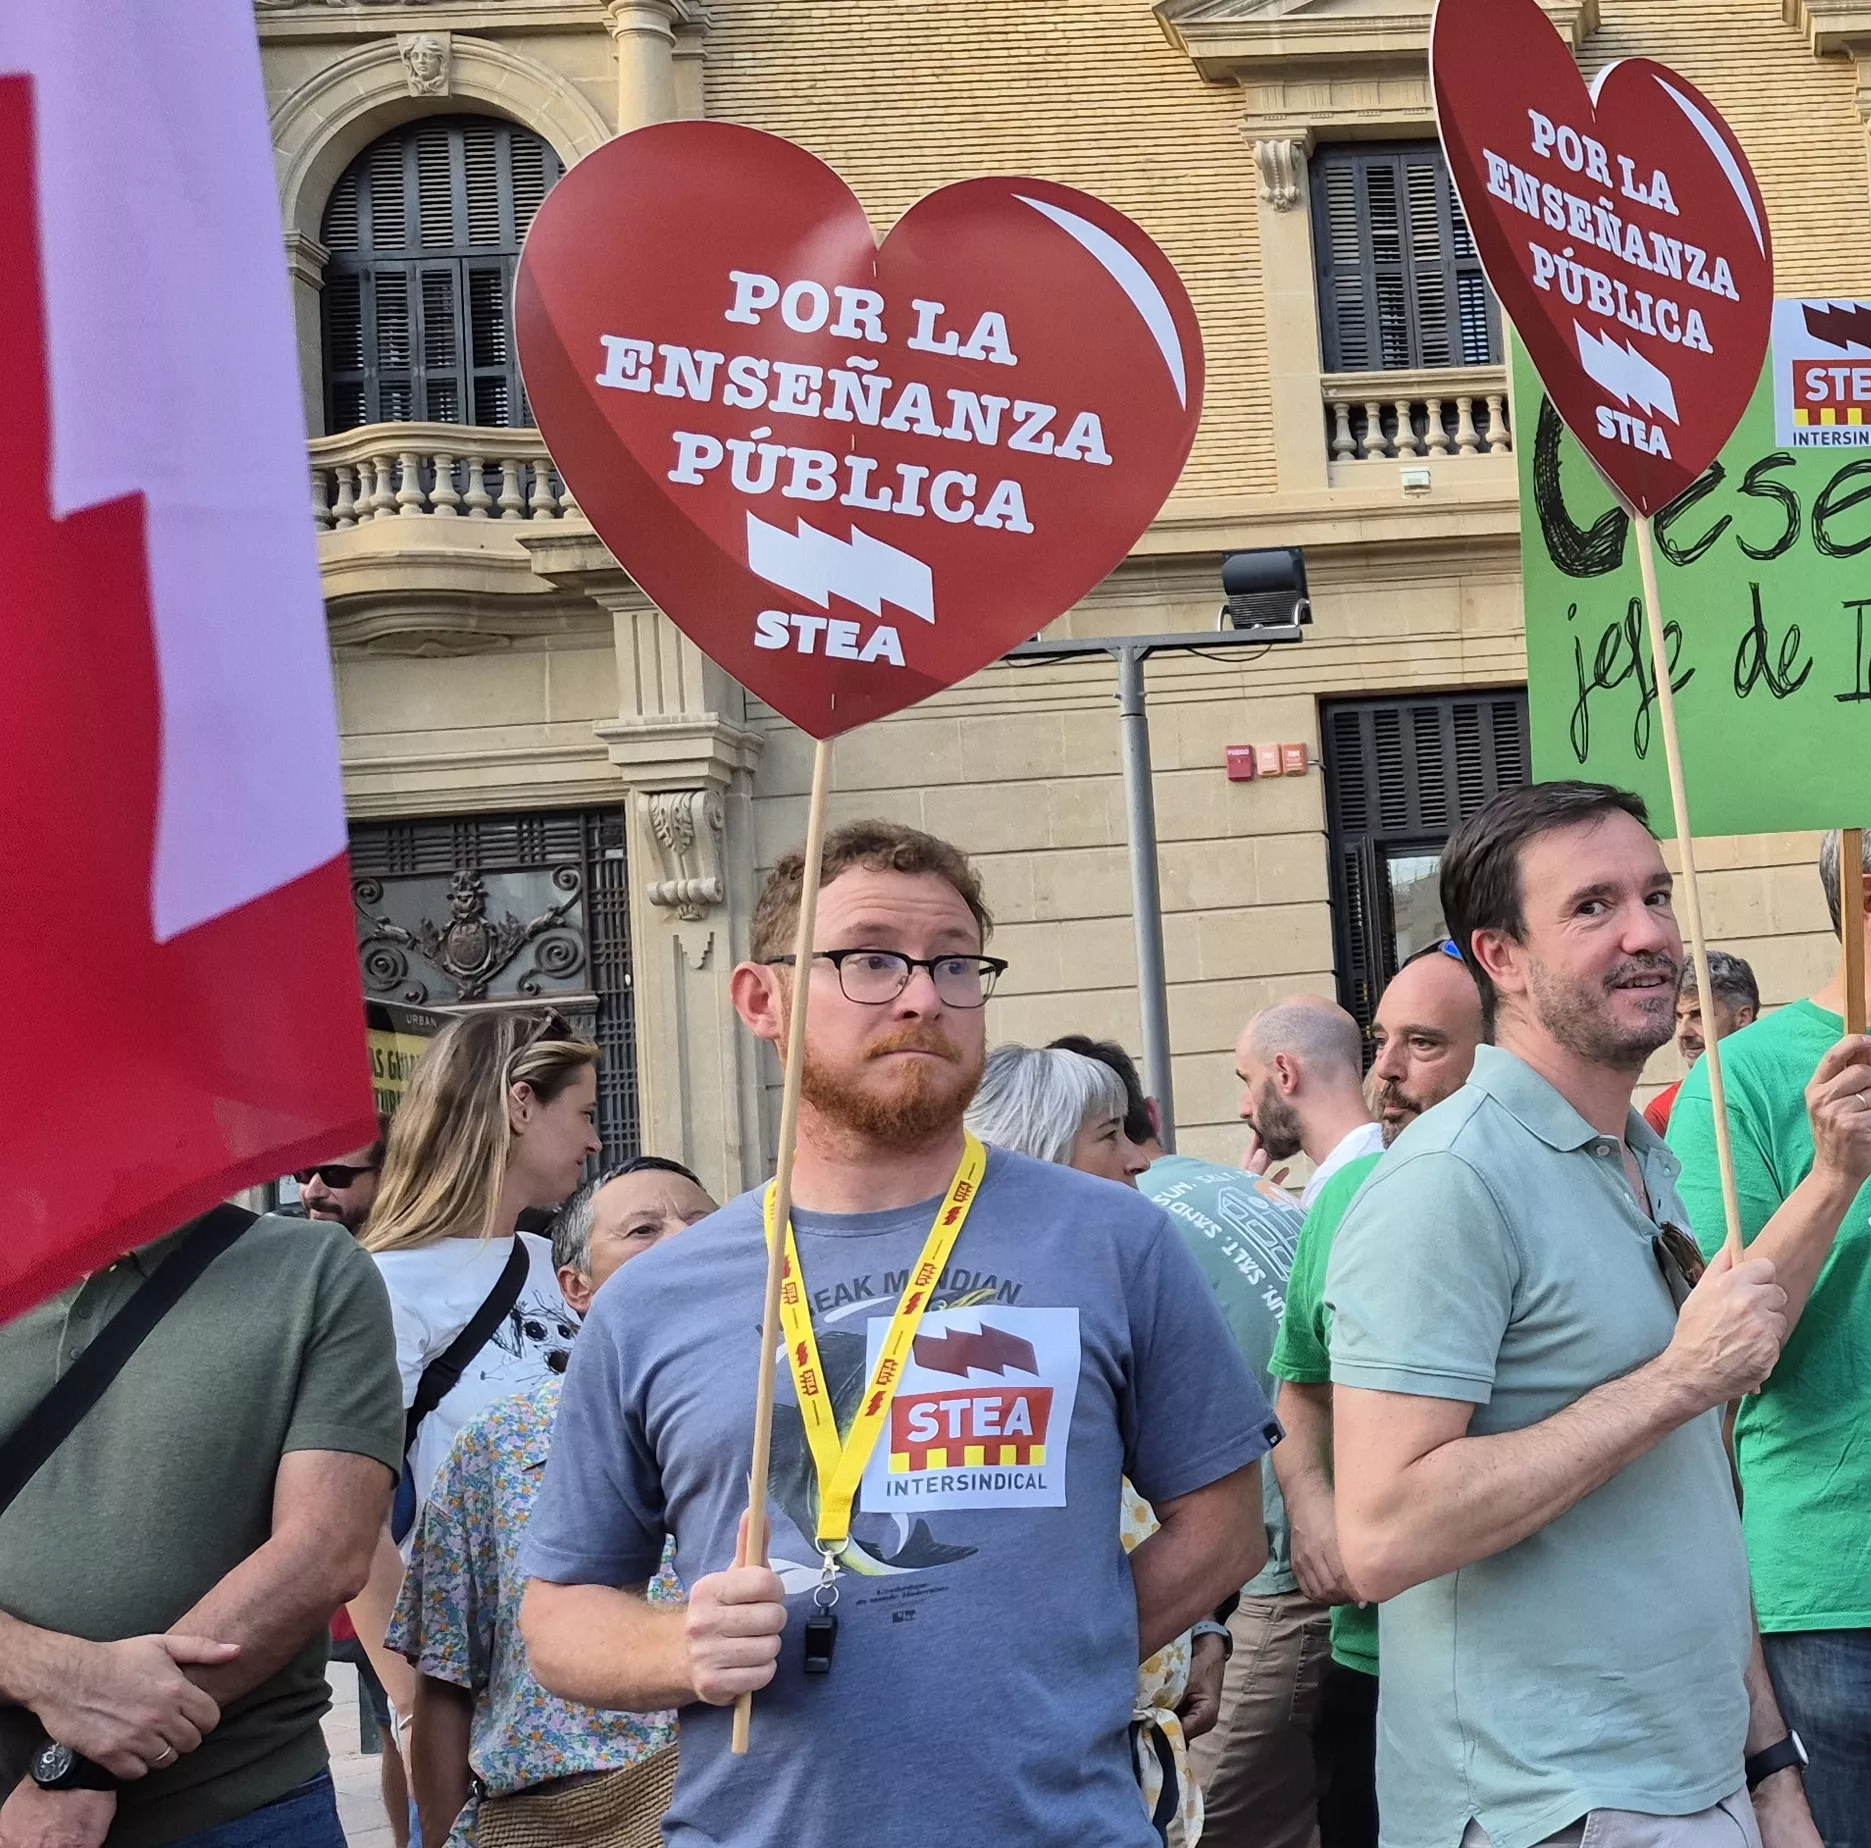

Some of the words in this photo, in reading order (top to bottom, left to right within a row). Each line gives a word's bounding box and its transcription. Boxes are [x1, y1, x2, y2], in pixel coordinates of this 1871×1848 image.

[1527, 108, 1612, 188] POR
[1617, 154, 1680, 216] LA
[1482, 148, 1740, 301] ENSEÑANZA
[724, 270, 888, 344] POR
[907, 298, 1018, 366] LA
[1528, 242, 1713, 354] PÚBLICA
[595, 334, 1113, 465] ENSEÑANZA
[1595, 405, 1672, 460] STEA
[667, 426, 1034, 534] PÚBLICA
[754, 610, 906, 667] STEA
[1568, 596, 1696, 764] jefe
[1733, 582, 1813, 700] de
[406, 1012, 437, 1027] URBAN
[808, 1275, 873, 1316] EAK
[883, 1268, 1023, 1304] MIDIAN
[907, 1397, 1033, 1442] STEA
[886, 1472, 1047, 1497] INTERSINDICAL
